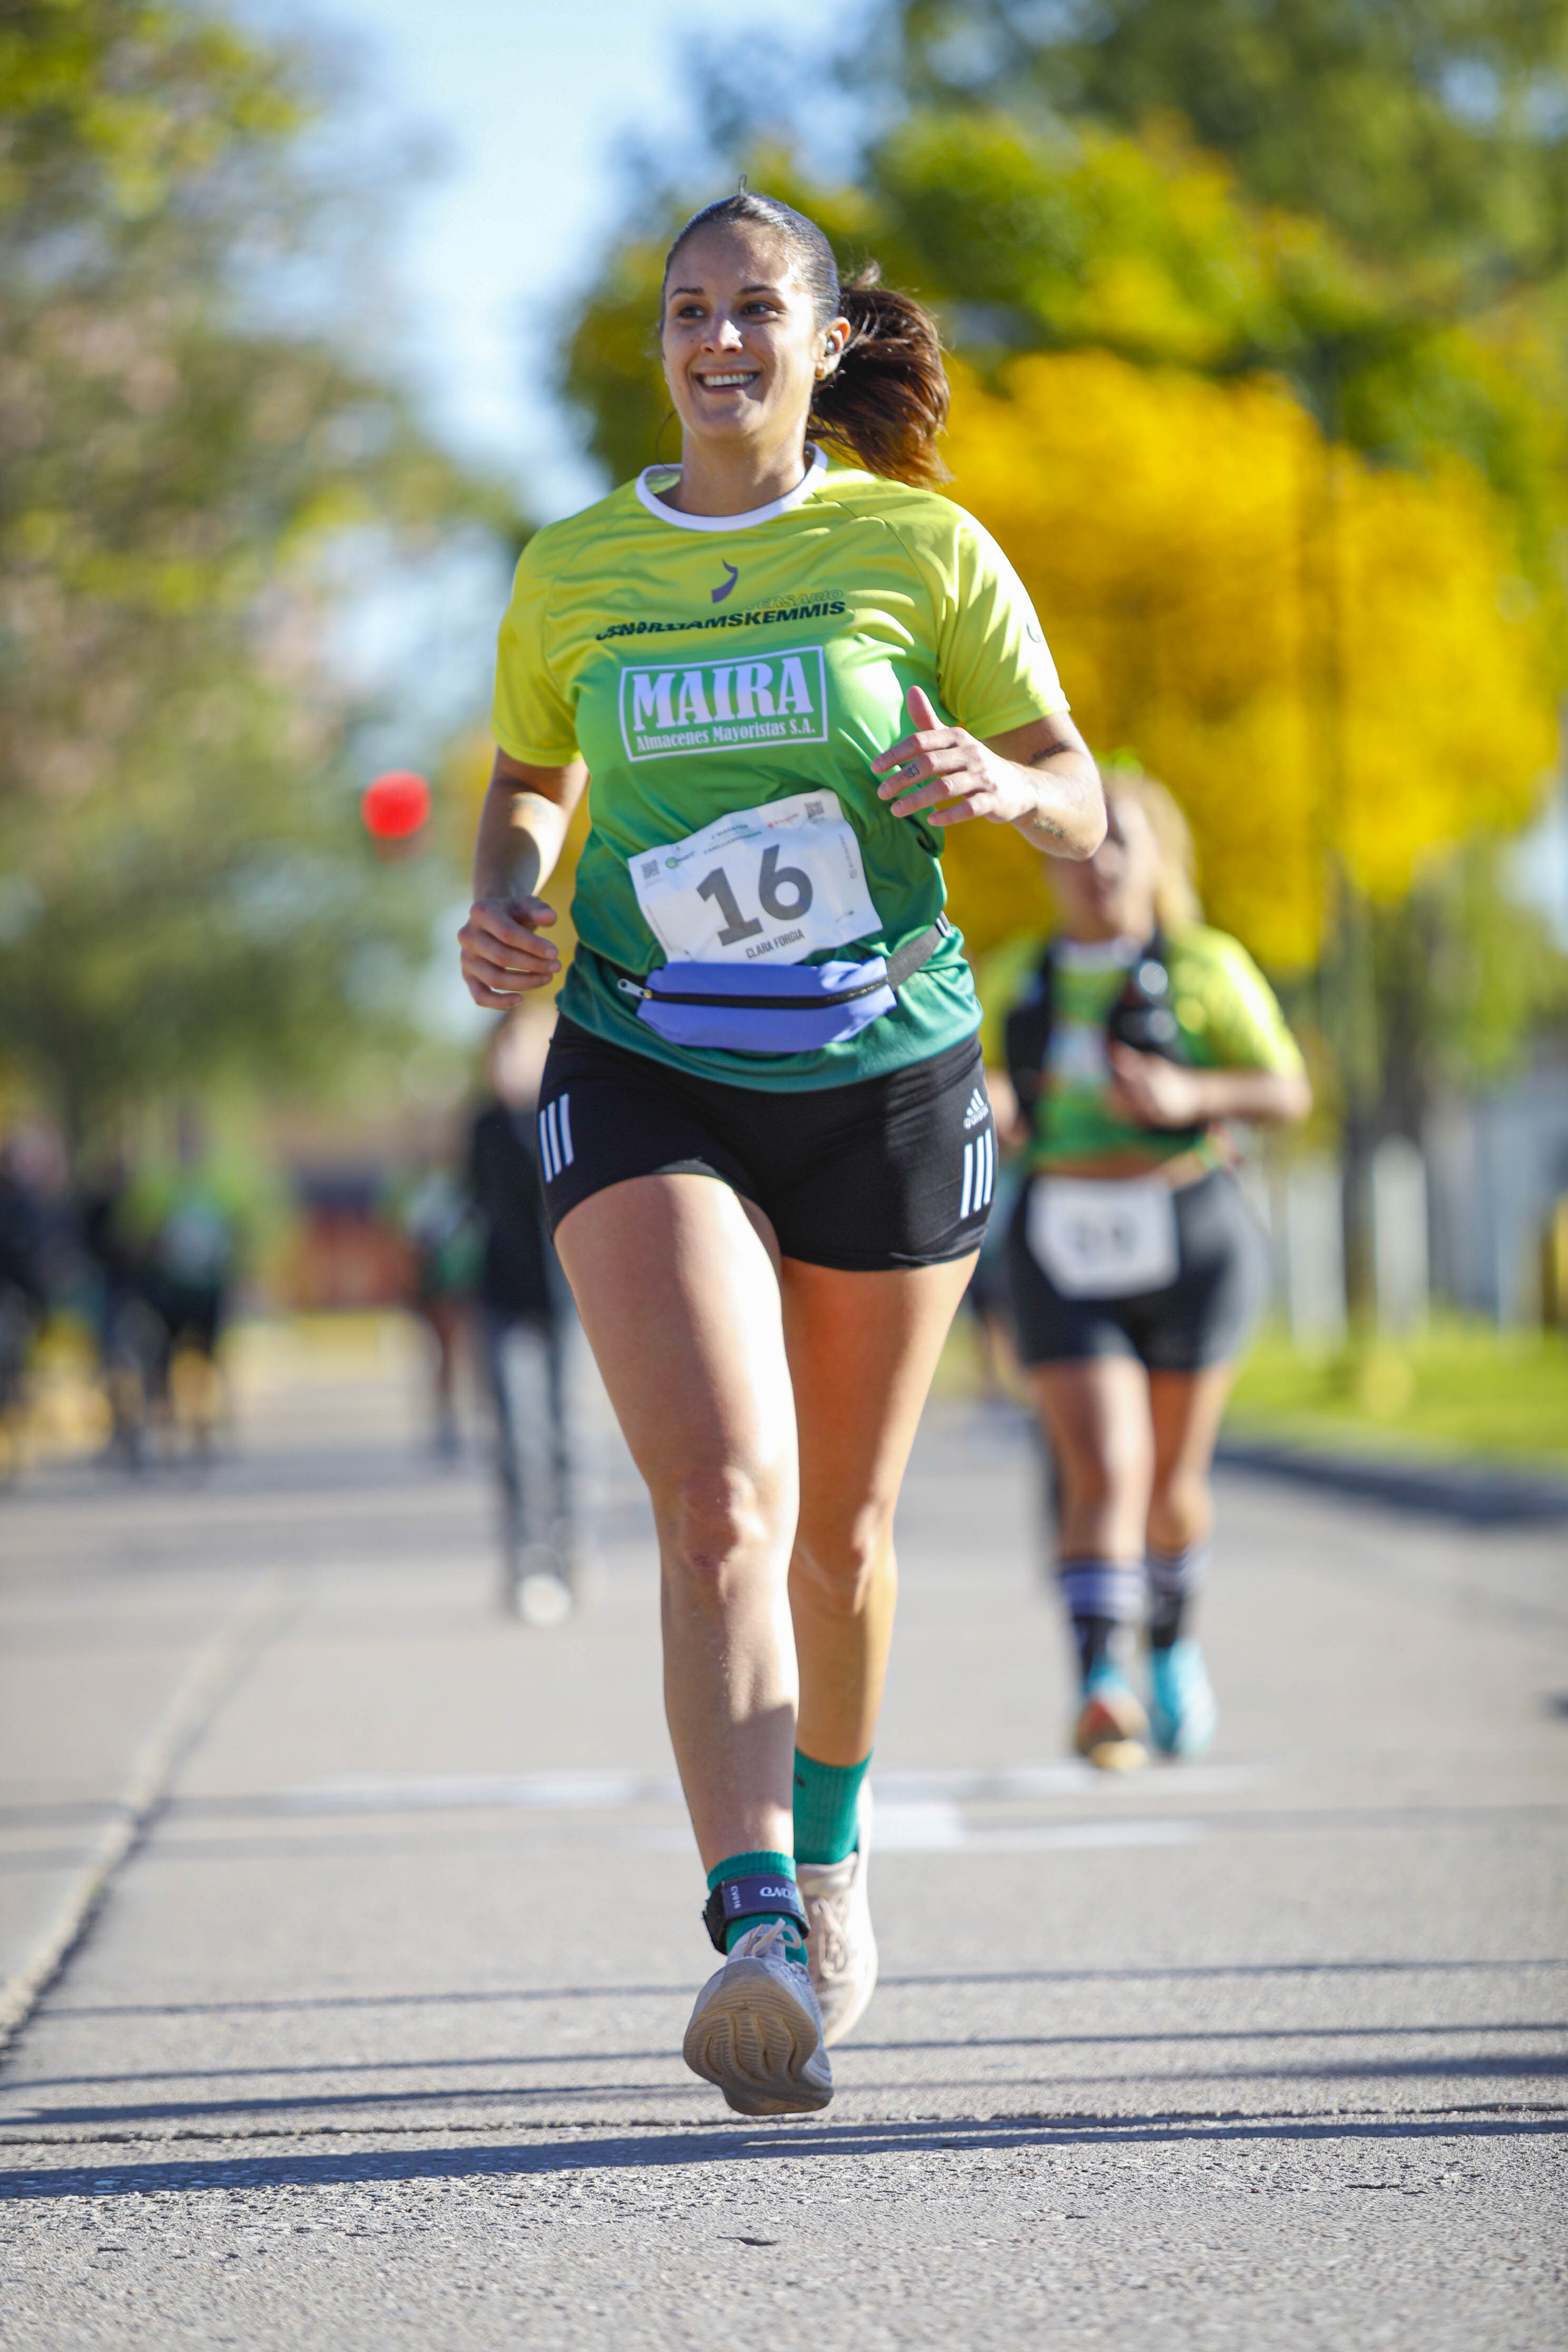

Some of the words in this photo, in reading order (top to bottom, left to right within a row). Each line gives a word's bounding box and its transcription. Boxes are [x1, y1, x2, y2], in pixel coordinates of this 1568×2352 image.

[633, 656, 814, 732] MAIRA
[636, 730, 709, 751] Almacenes
[712, 721, 787, 742] Mayoristas
[789, 718, 816, 734] S.A.
[697, 844, 813, 946] 16
[746, 940, 774, 958] CLARA
